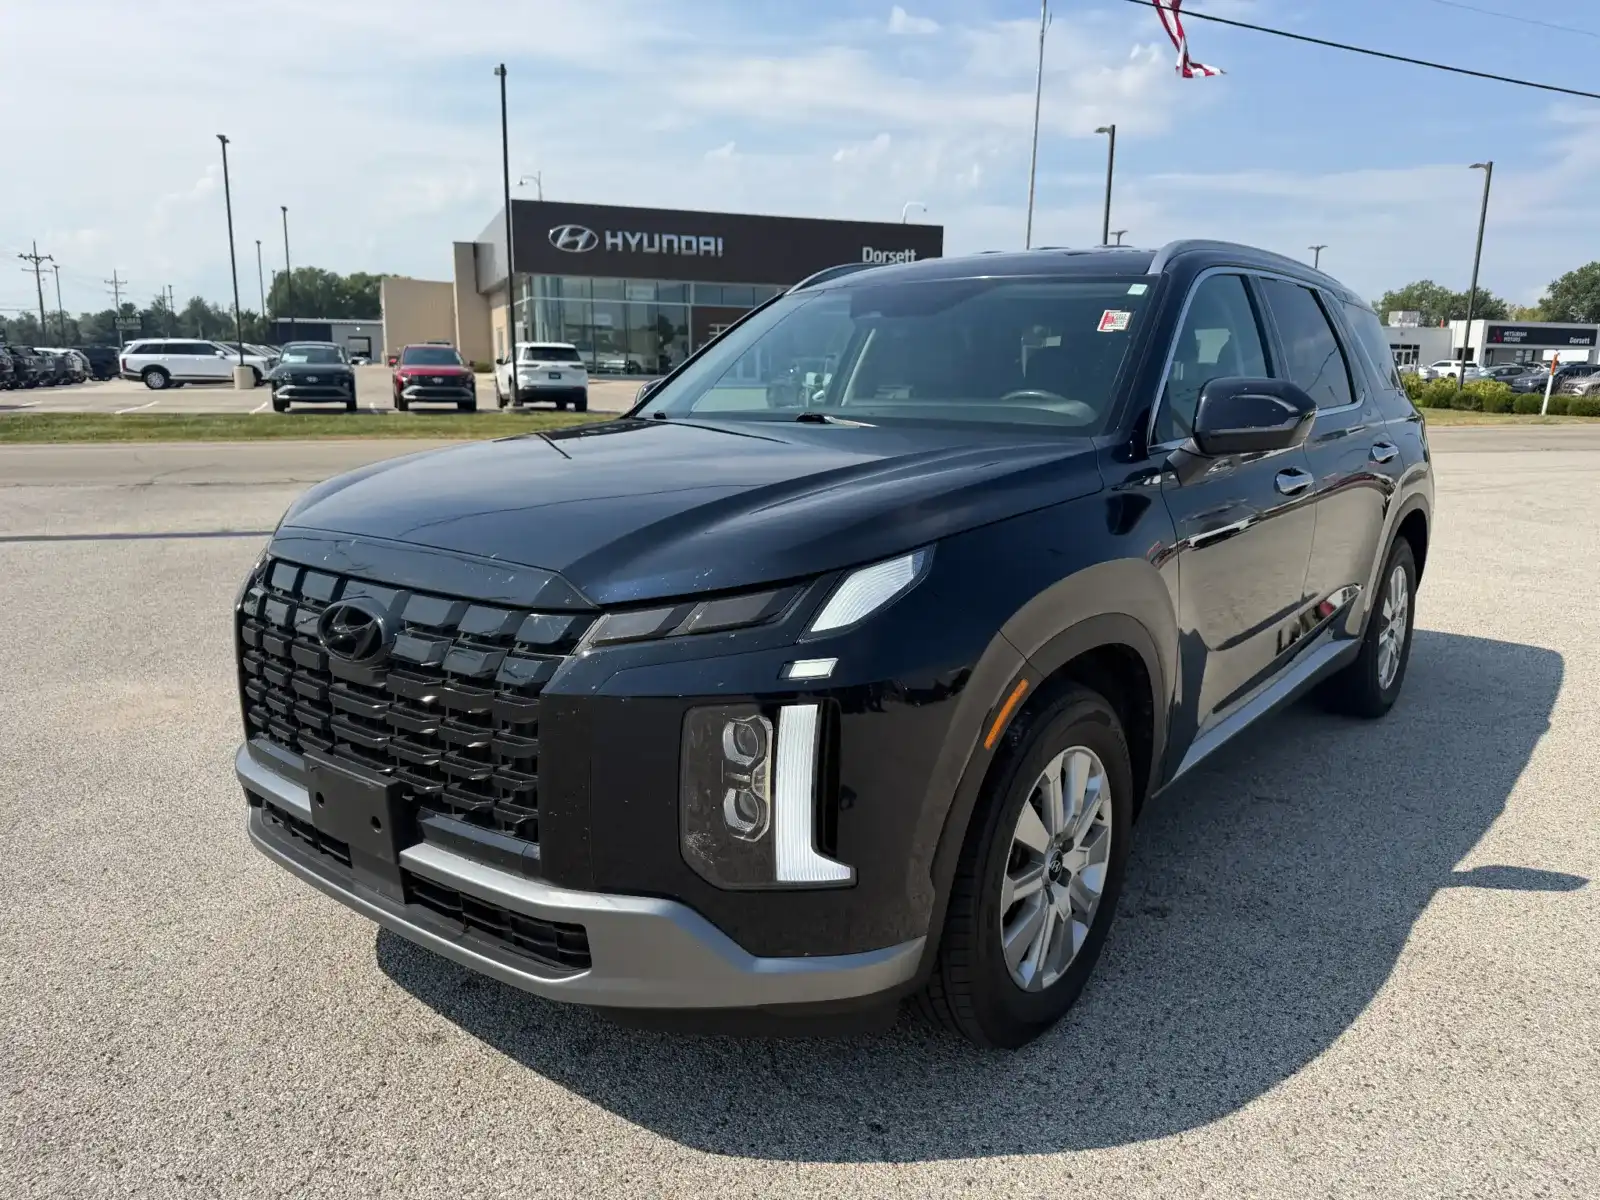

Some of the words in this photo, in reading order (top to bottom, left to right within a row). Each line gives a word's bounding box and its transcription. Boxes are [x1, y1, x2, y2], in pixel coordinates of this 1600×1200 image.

[604, 230, 724, 258] HYUNDAI
[862, 246, 917, 264] Dorsett
[1568, 336, 1591, 345] Dorsett
